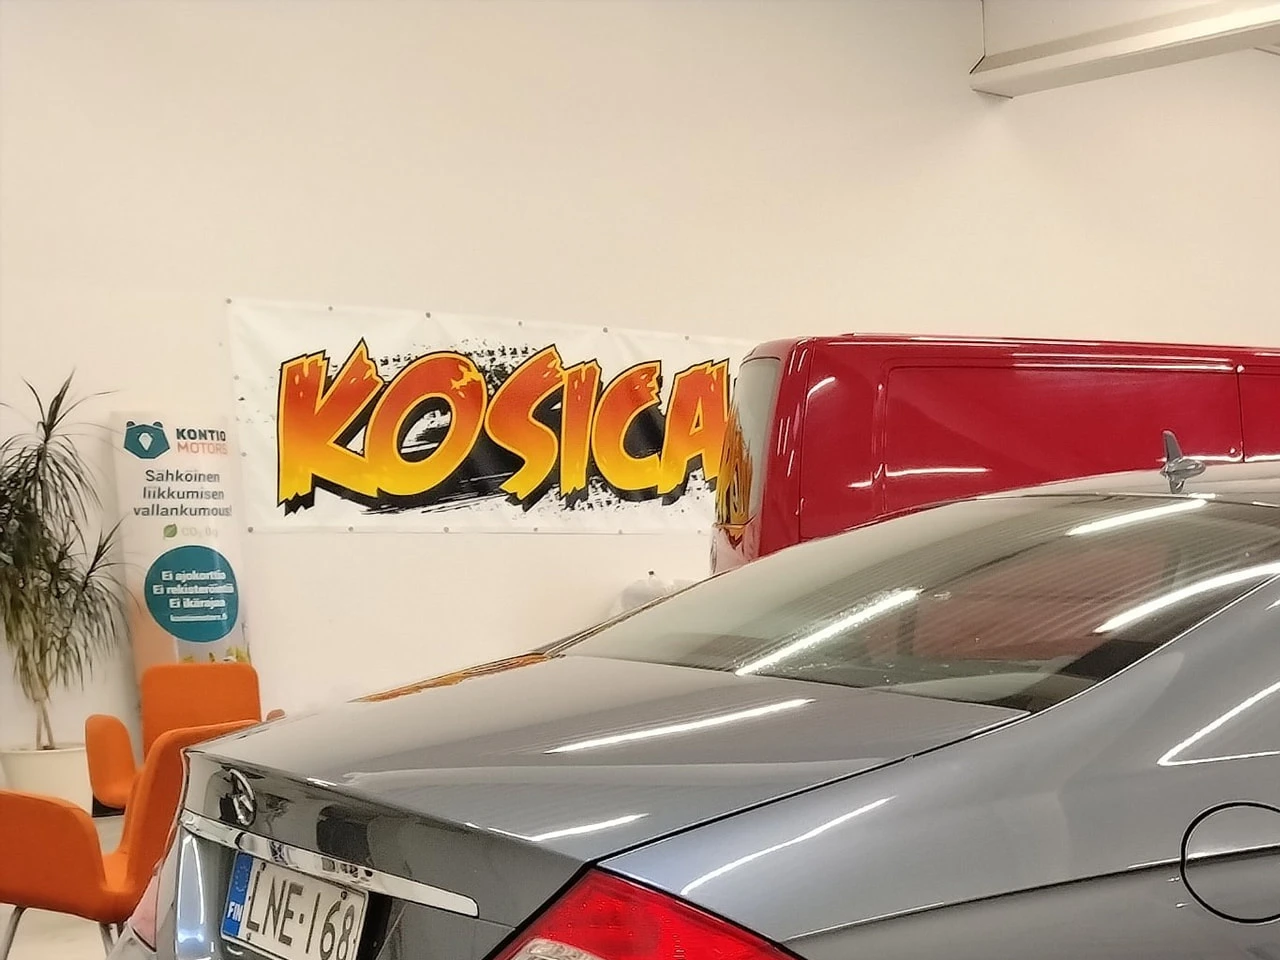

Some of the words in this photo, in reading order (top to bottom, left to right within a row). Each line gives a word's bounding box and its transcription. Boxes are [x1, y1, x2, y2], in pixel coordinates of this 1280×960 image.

[277, 338, 737, 515] KOSICA
[176, 428, 227, 442] KONTIO
[177, 442, 229, 455] MOTORS
[143, 486, 225, 500] liikkumisen
[162, 571, 173, 581] Ei
[153, 585, 164, 595] Ei
[169, 598, 181, 608] Ei
[226, 901, 245, 922] FIN
